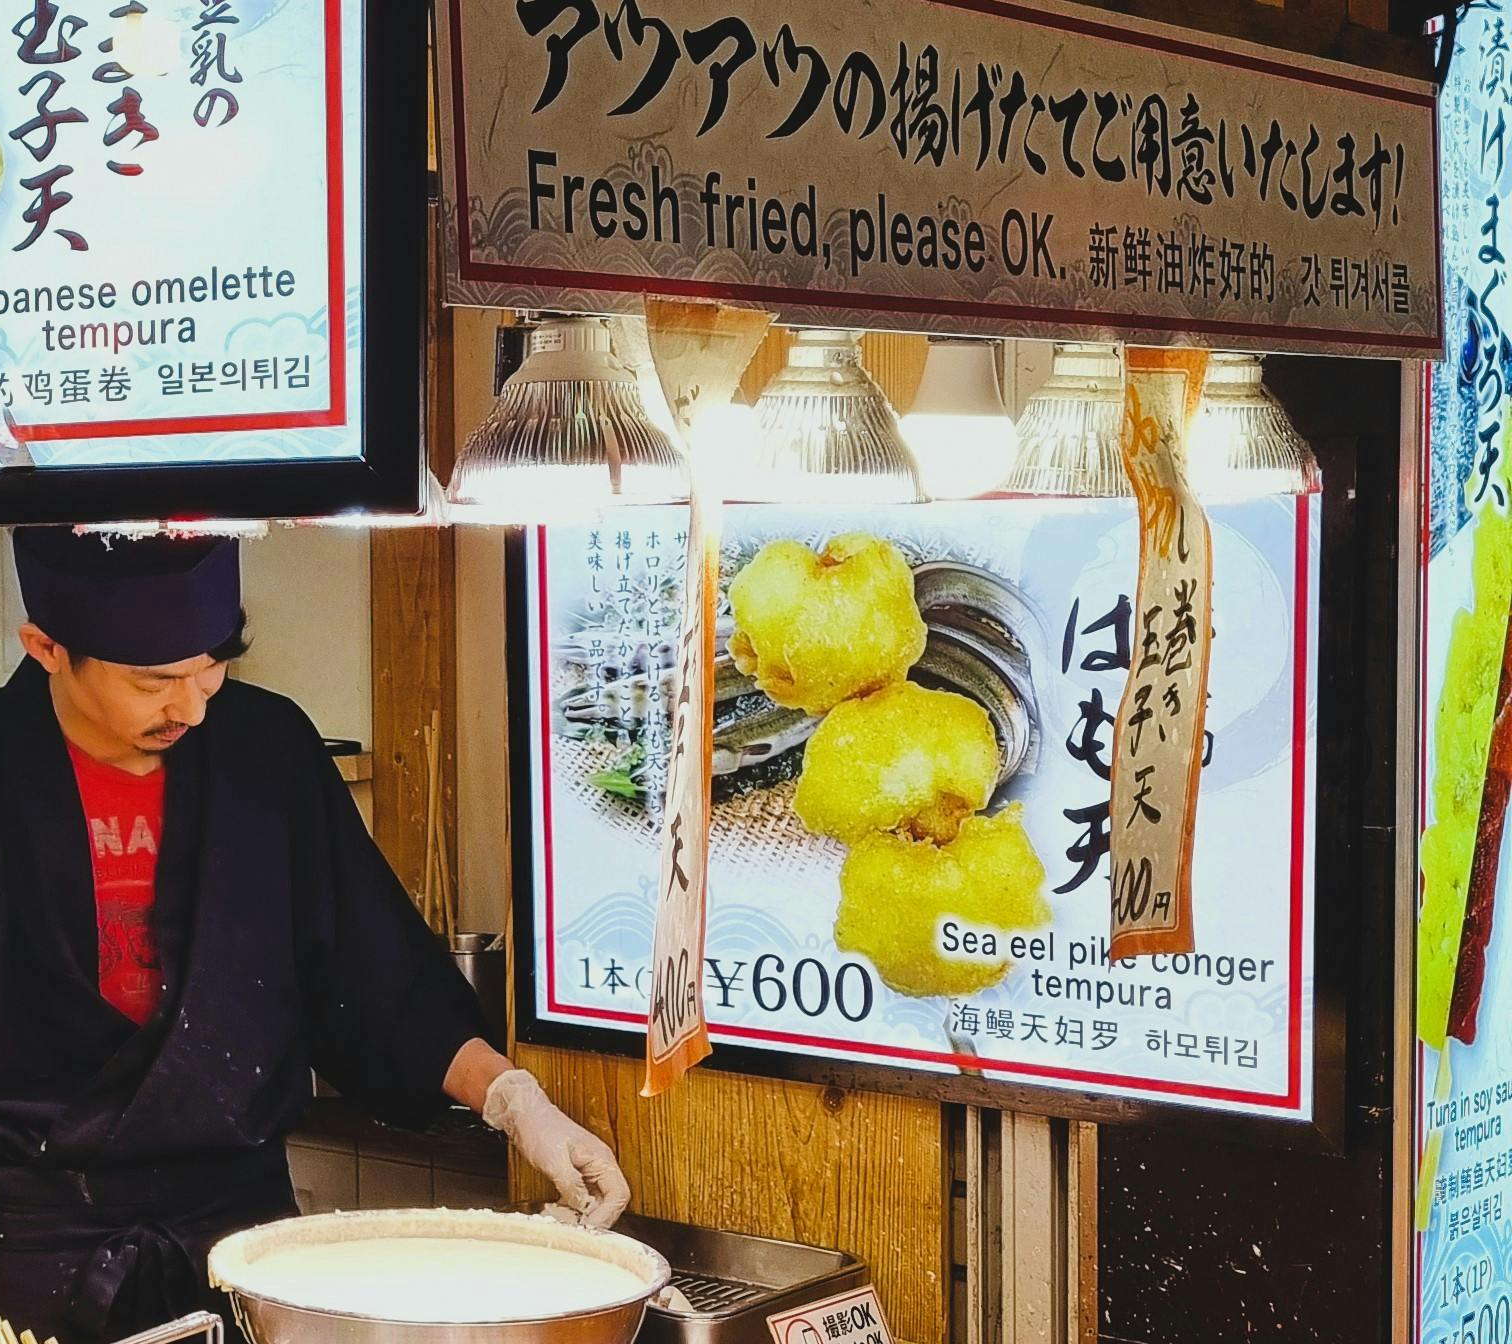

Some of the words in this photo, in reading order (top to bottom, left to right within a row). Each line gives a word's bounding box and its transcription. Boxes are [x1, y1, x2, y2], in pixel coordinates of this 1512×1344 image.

[528, 152, 682, 244] Fresh
[699, 172, 833, 270] fried,
[850, 199, 986, 279] please
[1000, 208, 1067, 283] OK.
[131, 265, 296, 307] omelette
[1088, 225, 1276, 307] 新鲜油炸好的
[41, 316, 197, 354] tempura
[157, 355, 311, 398] 일본의튀김
[941, 921, 997, 958] Sea
[1010, 931, 1055, 963] eel
[1150, 950, 1276, 991] conger
[703, 953, 874, 1024] ¥600
[1030, 967, 1172, 1011] tempura
[1145, 1027, 1260, 1070] 하모튀김
[1426, 1096, 1458, 1131] Tuna
[1460, 1090, 1471, 1118] in
[1473, 1085, 1494, 1120] soy
[1453, 1113, 1502, 1154] tempura
